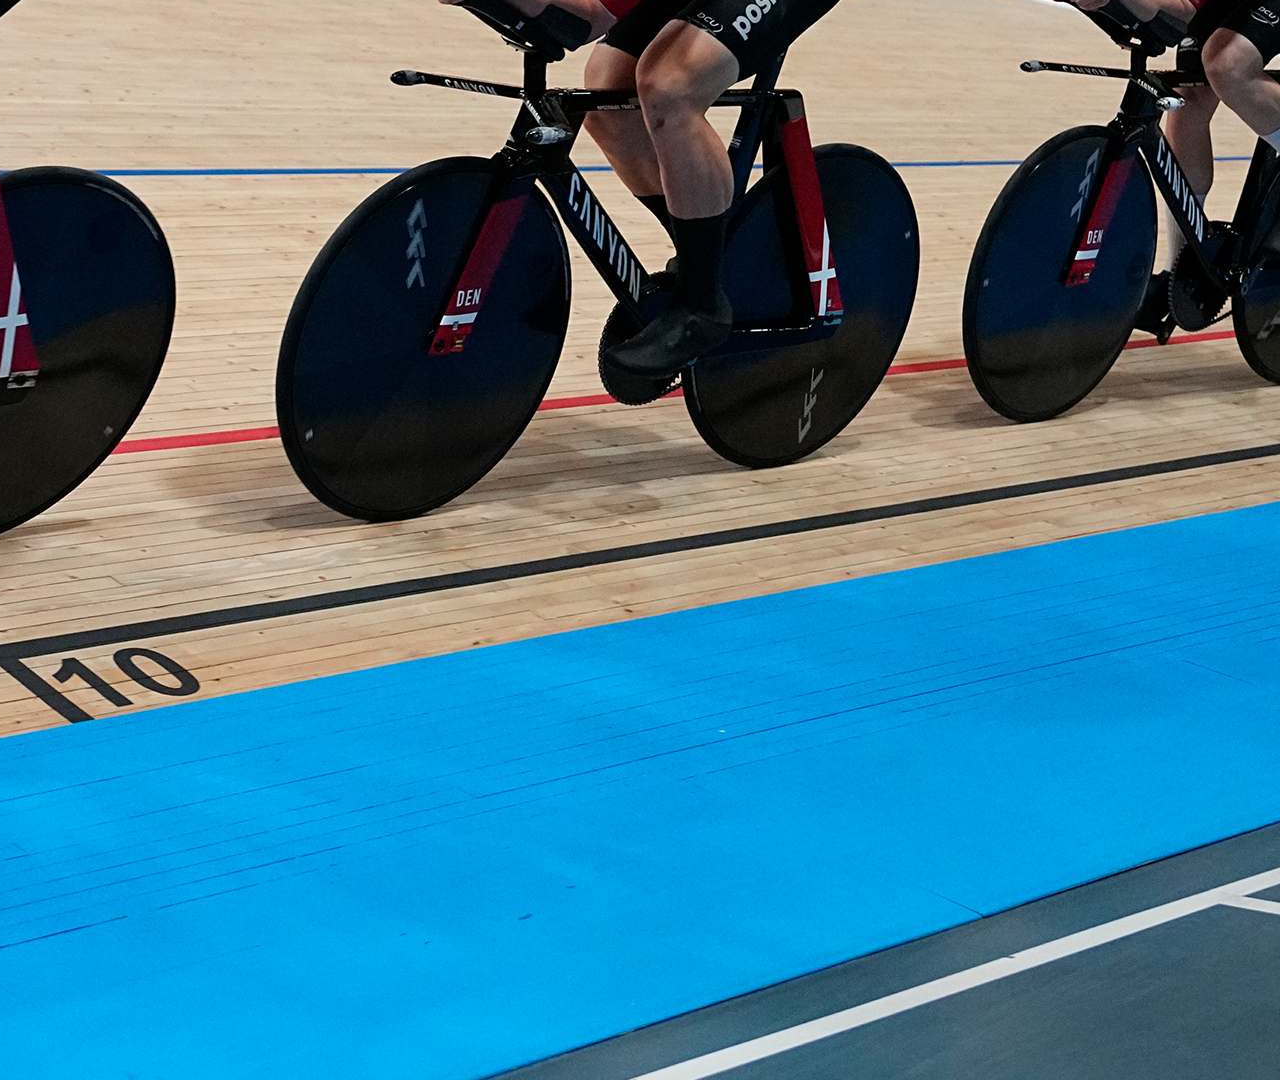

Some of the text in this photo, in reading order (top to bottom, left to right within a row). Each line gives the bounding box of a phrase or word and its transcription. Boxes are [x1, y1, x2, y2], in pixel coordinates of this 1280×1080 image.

[697, 12, 720, 27] DCU
[1062, 65, 1108, 77] CANYON
[444, 78, 497, 95] CANYON
[1157, 136, 1204, 243] CANYON
[568, 172, 641, 303] CANYON
[1086, 229, 1105, 245] DEN
[456, 288, 482, 308] DEN
[51, 647, 201, 708] 10
